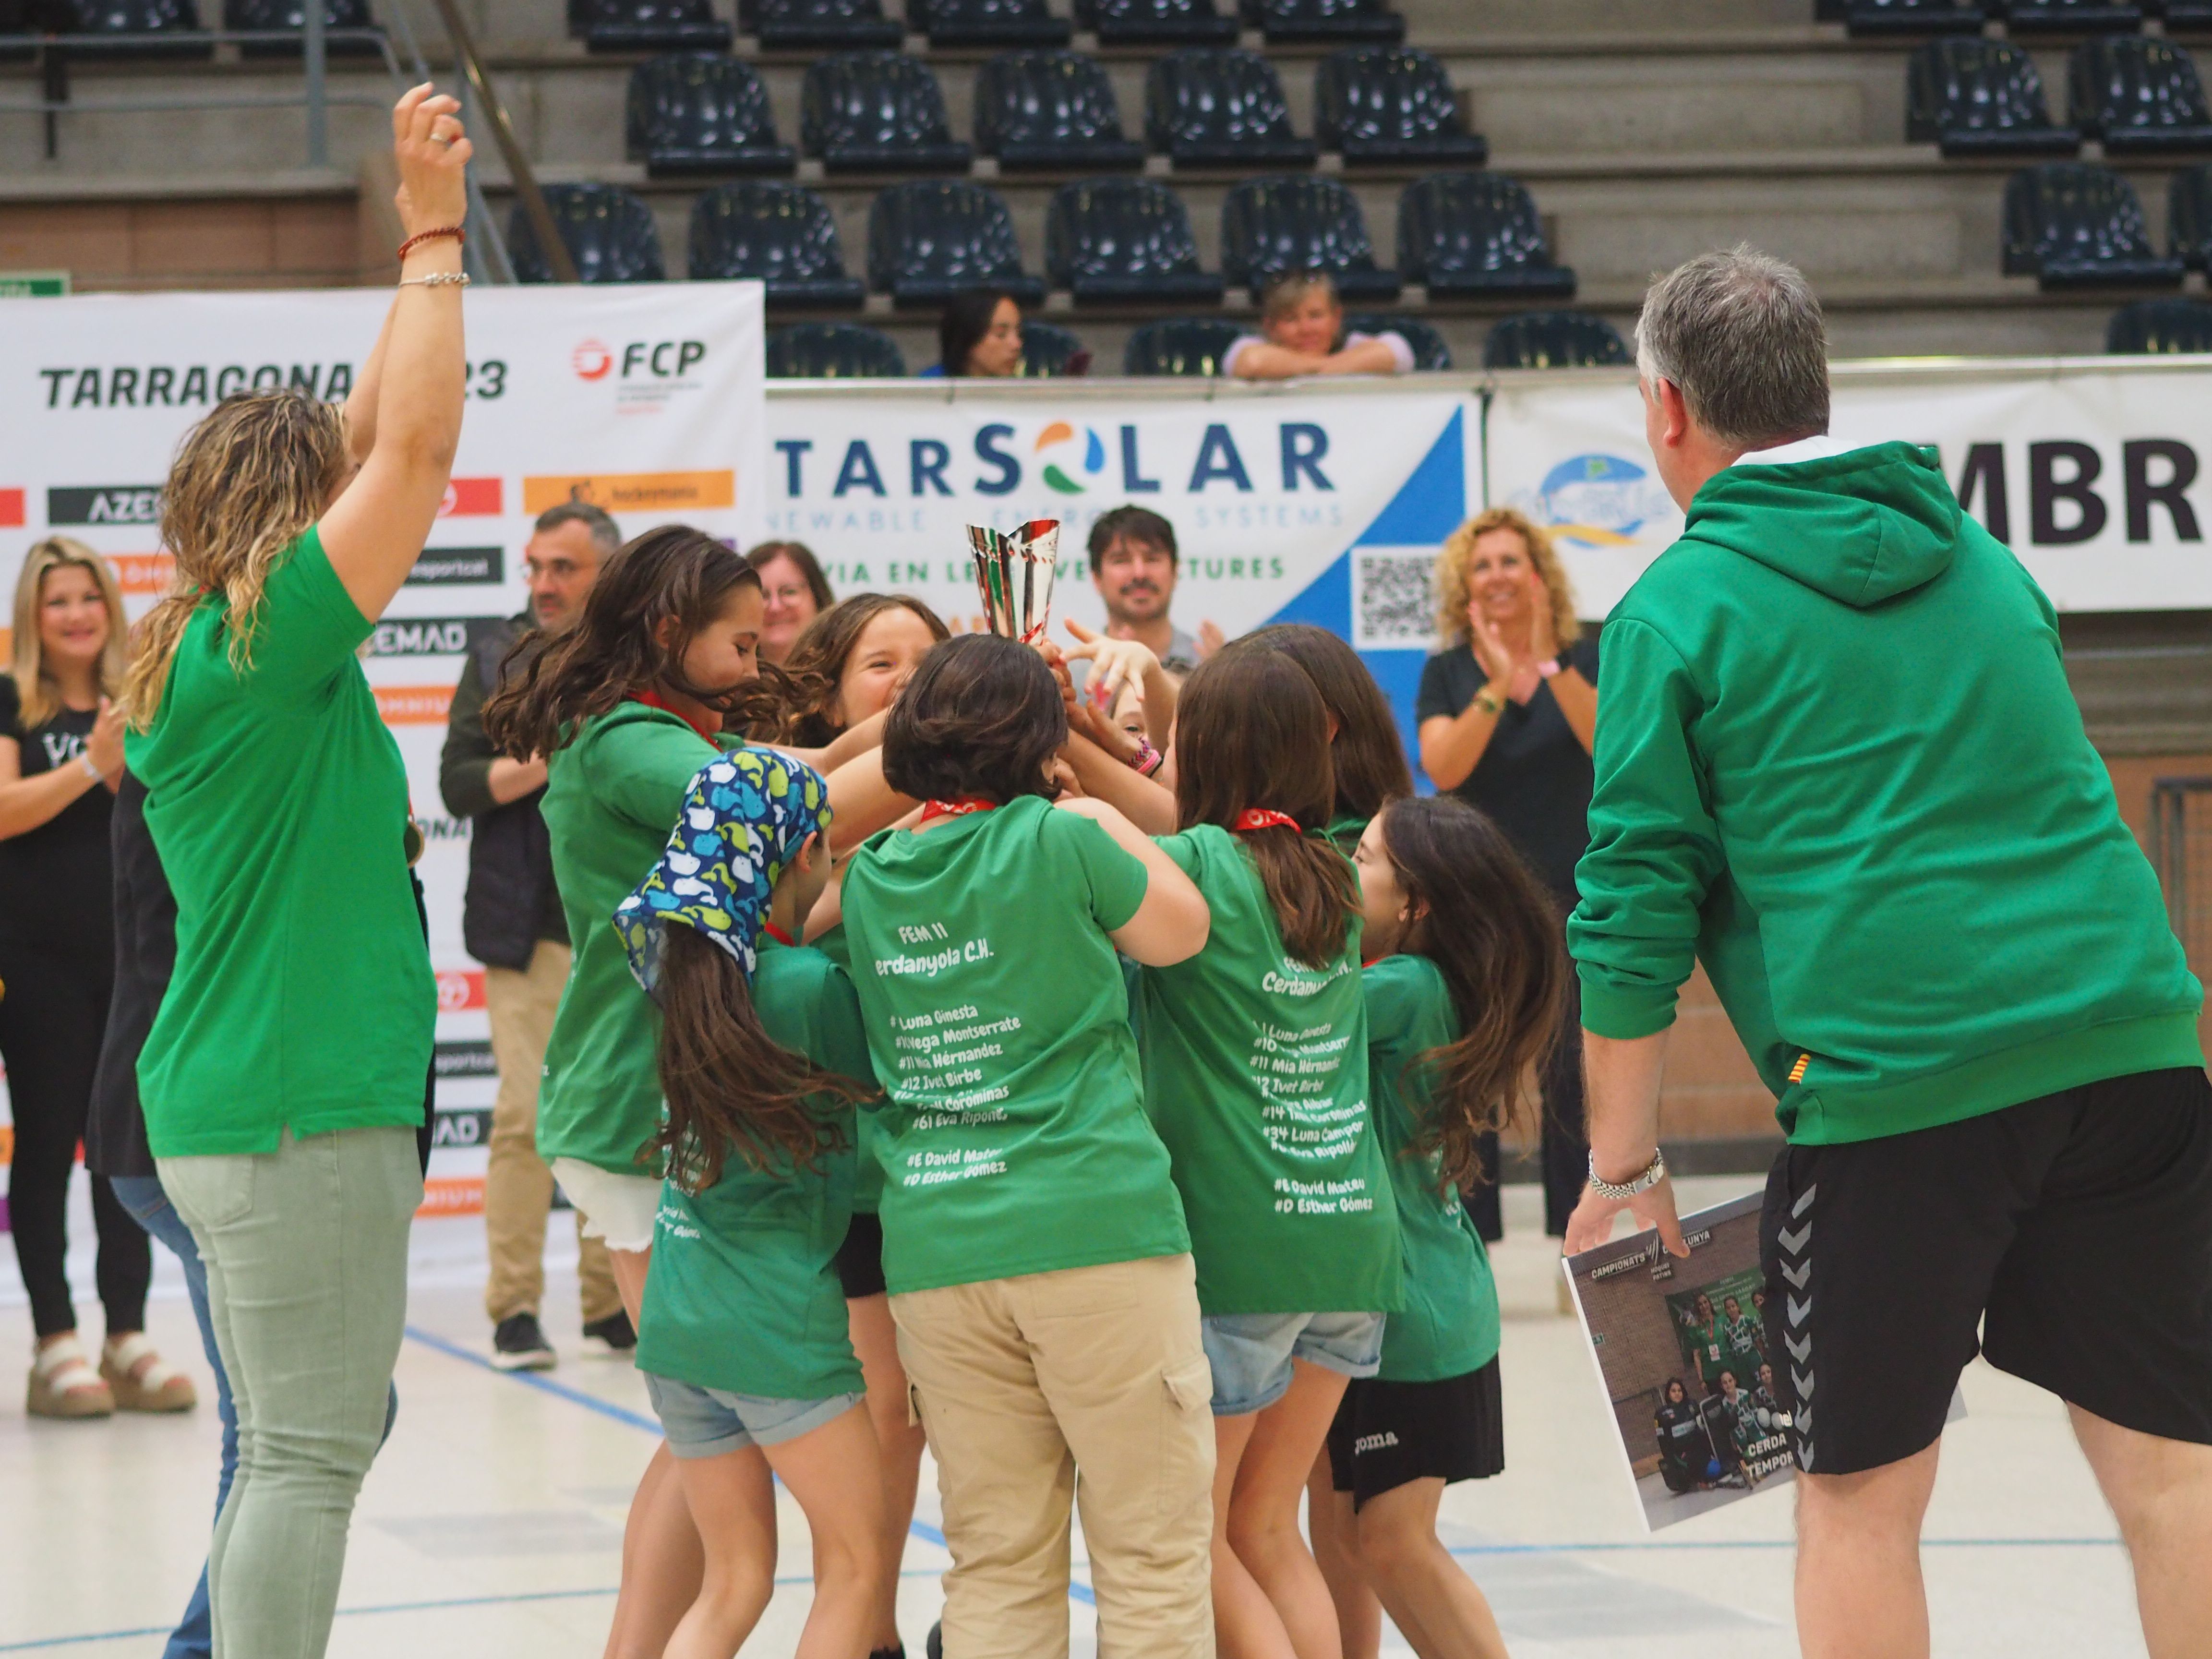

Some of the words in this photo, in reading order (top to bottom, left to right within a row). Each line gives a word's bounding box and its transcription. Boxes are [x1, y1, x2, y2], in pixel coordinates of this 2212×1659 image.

[622, 341, 705, 377] FCP
[39, 363, 352, 409] TARRAGONA
[88, 491, 163, 522] AZE
[1196, 503, 1343, 529] SYSTEMS
[889, 561, 928, 583] EN
[898, 925, 933, 945] FEM
[875, 947, 961, 977] erdanyola
[899, 1014, 934, 1032] Luna
[934, 1004, 979, 1024] Ginesta
[943, 1016, 1022, 1045] Montserrate
[1253, 1036, 1277, 1052] #10
[933, 1042, 1004, 1069] Hérnandez
[1250, 1055, 1269, 1070] #11
[1272, 1058, 1296, 1074] Mia
[901, 1075, 921, 1091] #12
[945, 1068, 983, 1087] Birbe
[1271, 1078, 1299, 1094] Ivet
[936, 1112, 958, 1128] Eva
[1262, 1105, 1286, 1120] #14
[1262, 1126, 1288, 1142] #34
[1291, 1127, 1320, 1142] Luna
[925, 1148, 962, 1167] David
[921, 1170, 963, 1186] Esther
[1291, 1180, 1325, 1196] David
[1327, 1178, 1365, 1196] Mateu
[1298, 1198, 1337, 1214] Esther
[1339, 1195, 1373, 1213] Gómez
[1591, 1252, 1646, 1279] CAMPIONATS
[1748, 1432, 1787, 1457] CERDA
